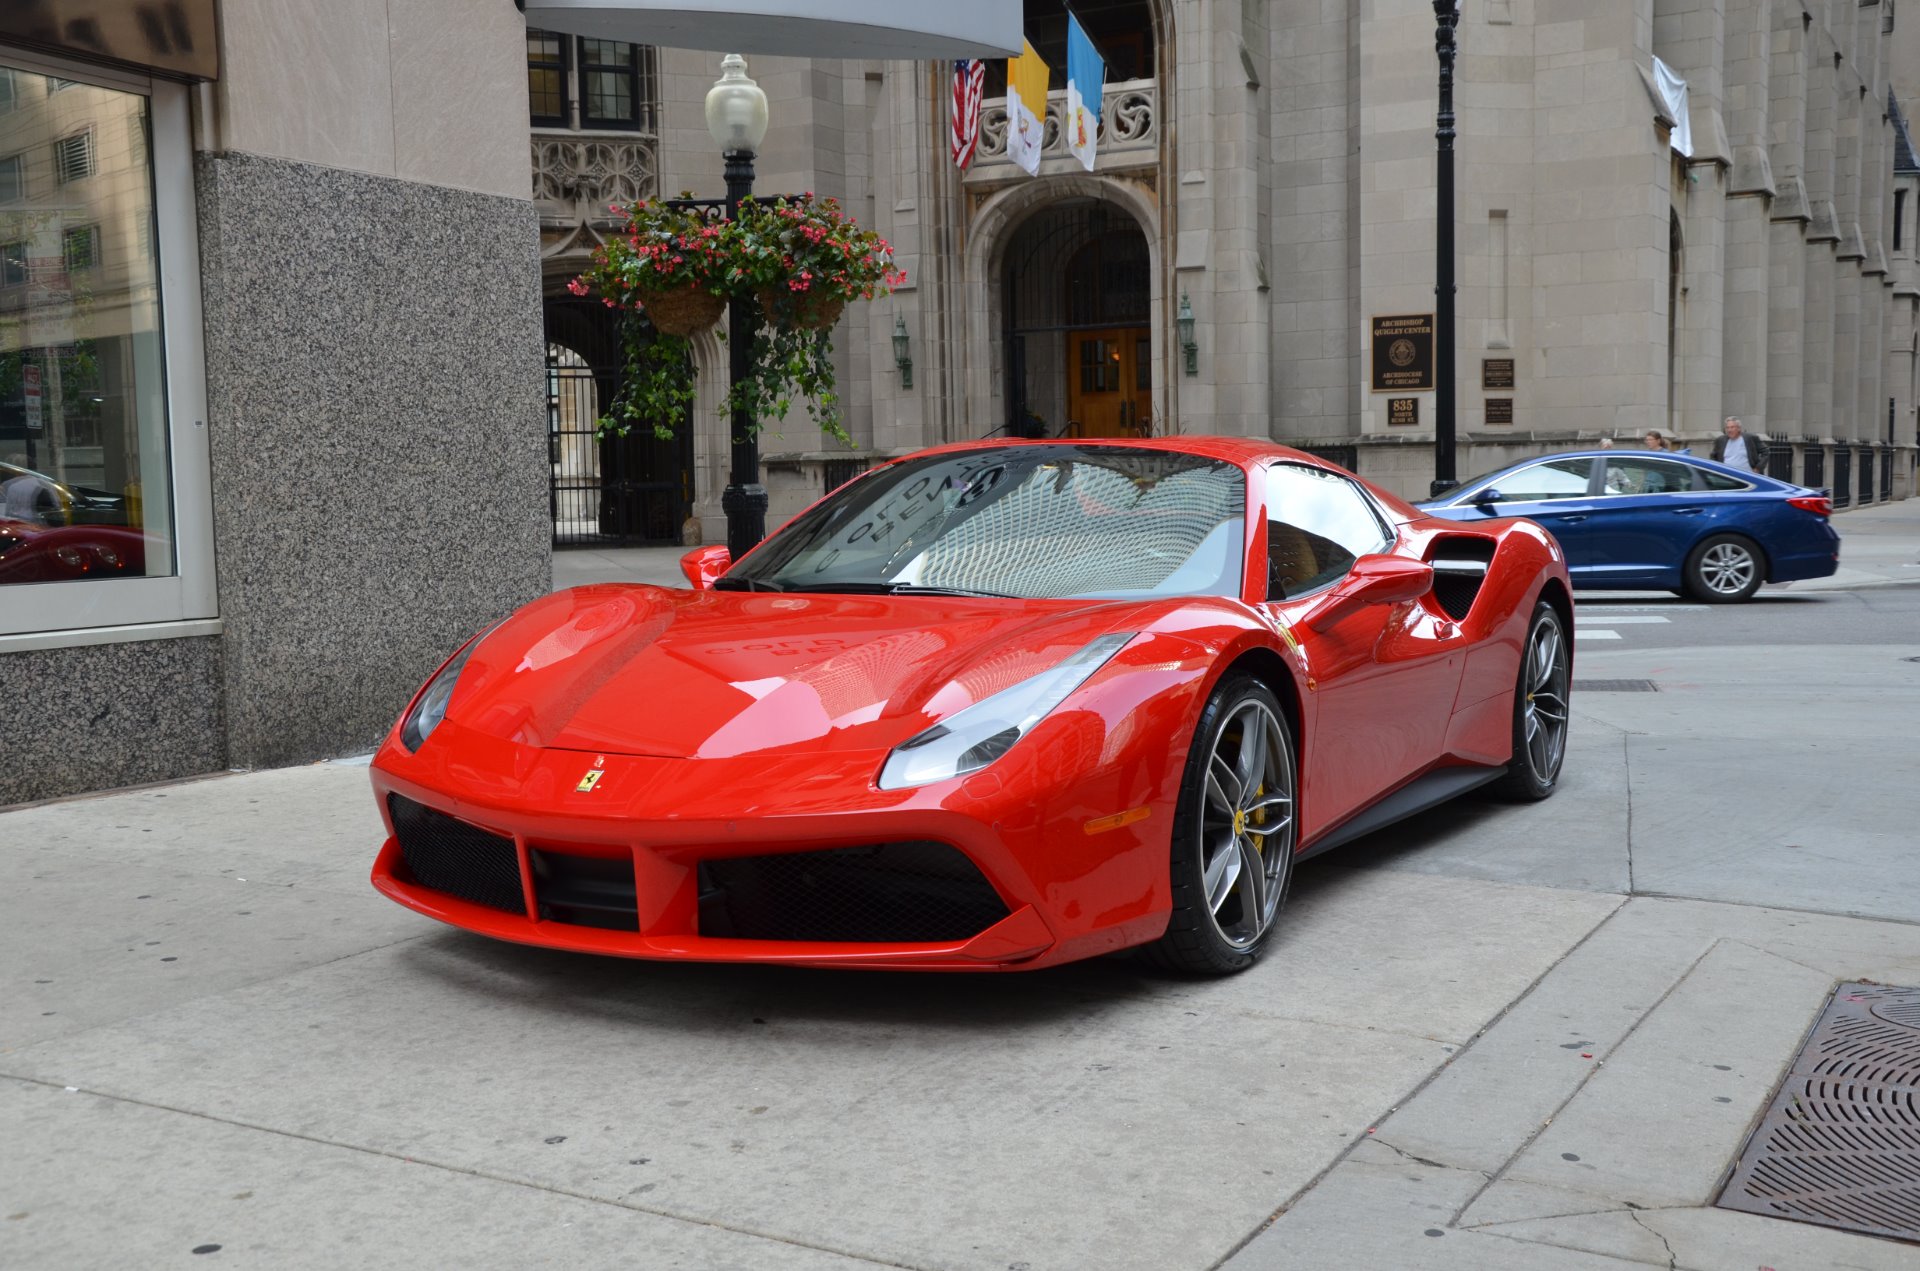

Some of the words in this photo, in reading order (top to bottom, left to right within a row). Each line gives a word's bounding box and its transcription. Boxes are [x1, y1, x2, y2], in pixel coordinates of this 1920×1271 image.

[1381, 318, 1424, 327] ARCHBISHOP
[1374, 327, 1403, 336] QUIGLEY
[1404, 326, 1431, 335] CENTER
[1393, 400, 1413, 411] 835
